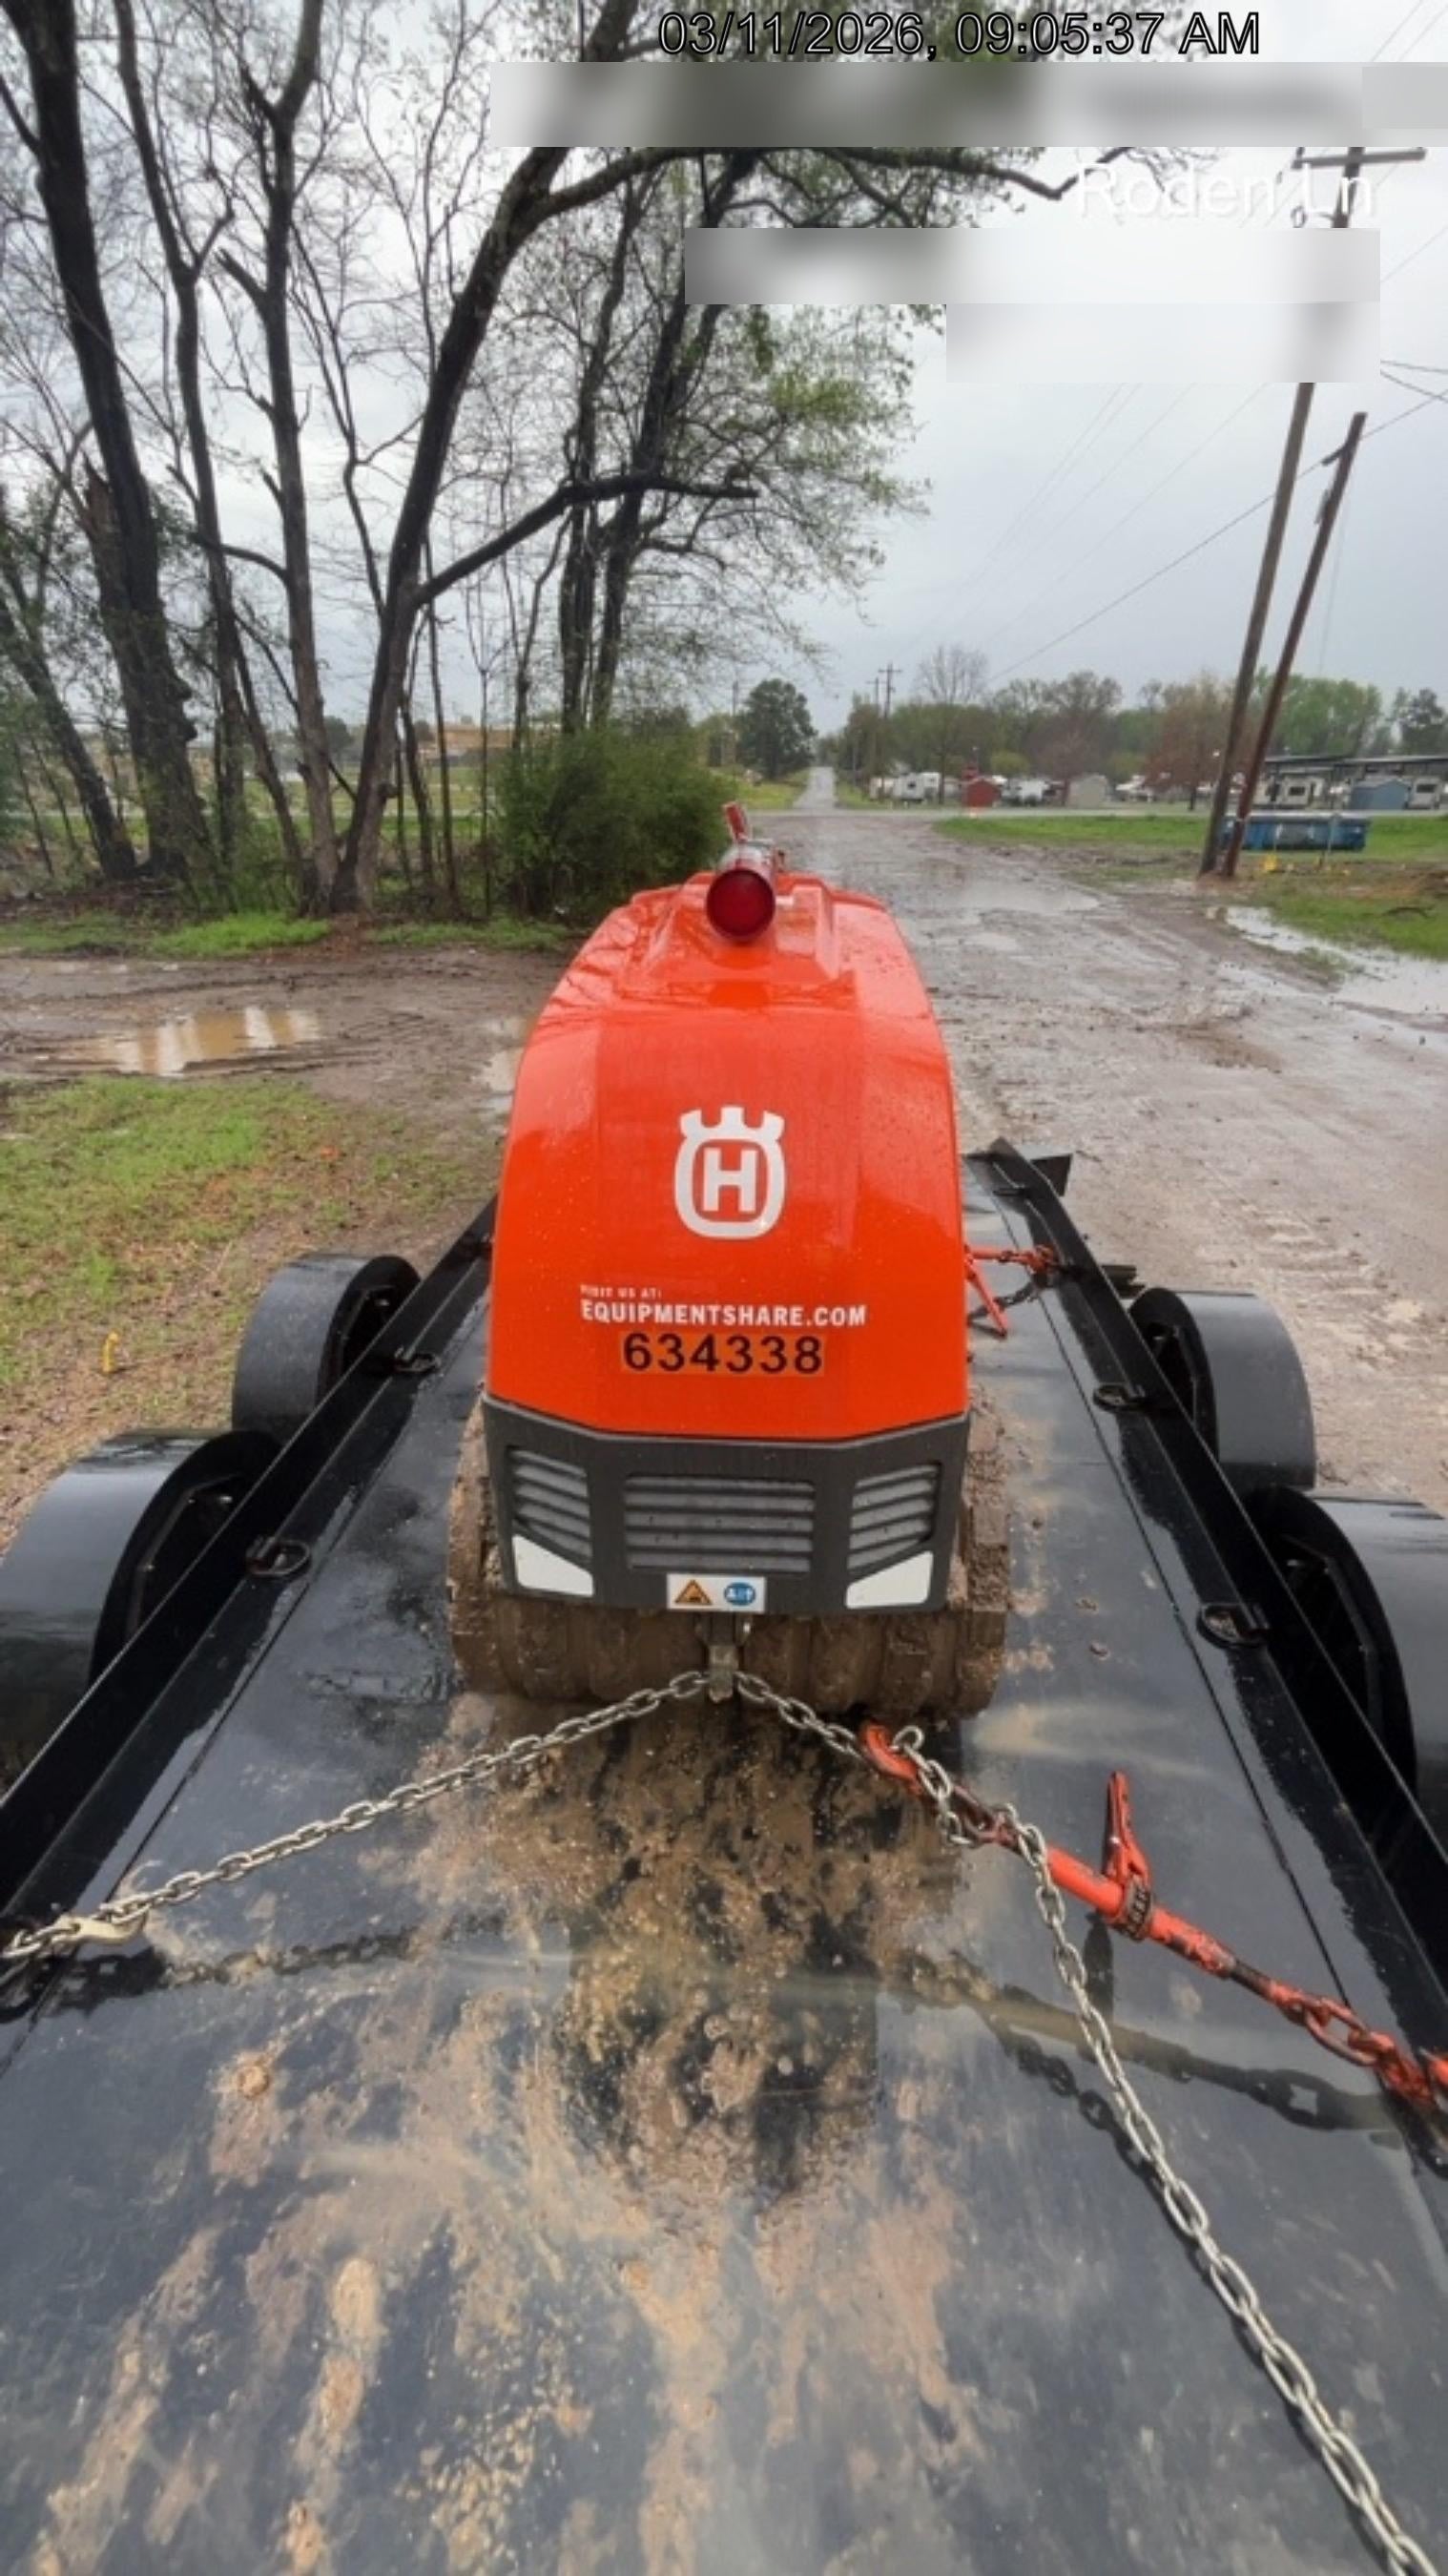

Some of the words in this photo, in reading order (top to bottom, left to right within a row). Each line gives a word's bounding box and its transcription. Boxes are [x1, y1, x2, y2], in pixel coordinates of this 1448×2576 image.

[703, 1148, 758, 1213] H
[582, 1298, 866, 1326] EQUIPMENTSHARE.COM
[623, 1333, 822, 1374] 634338
